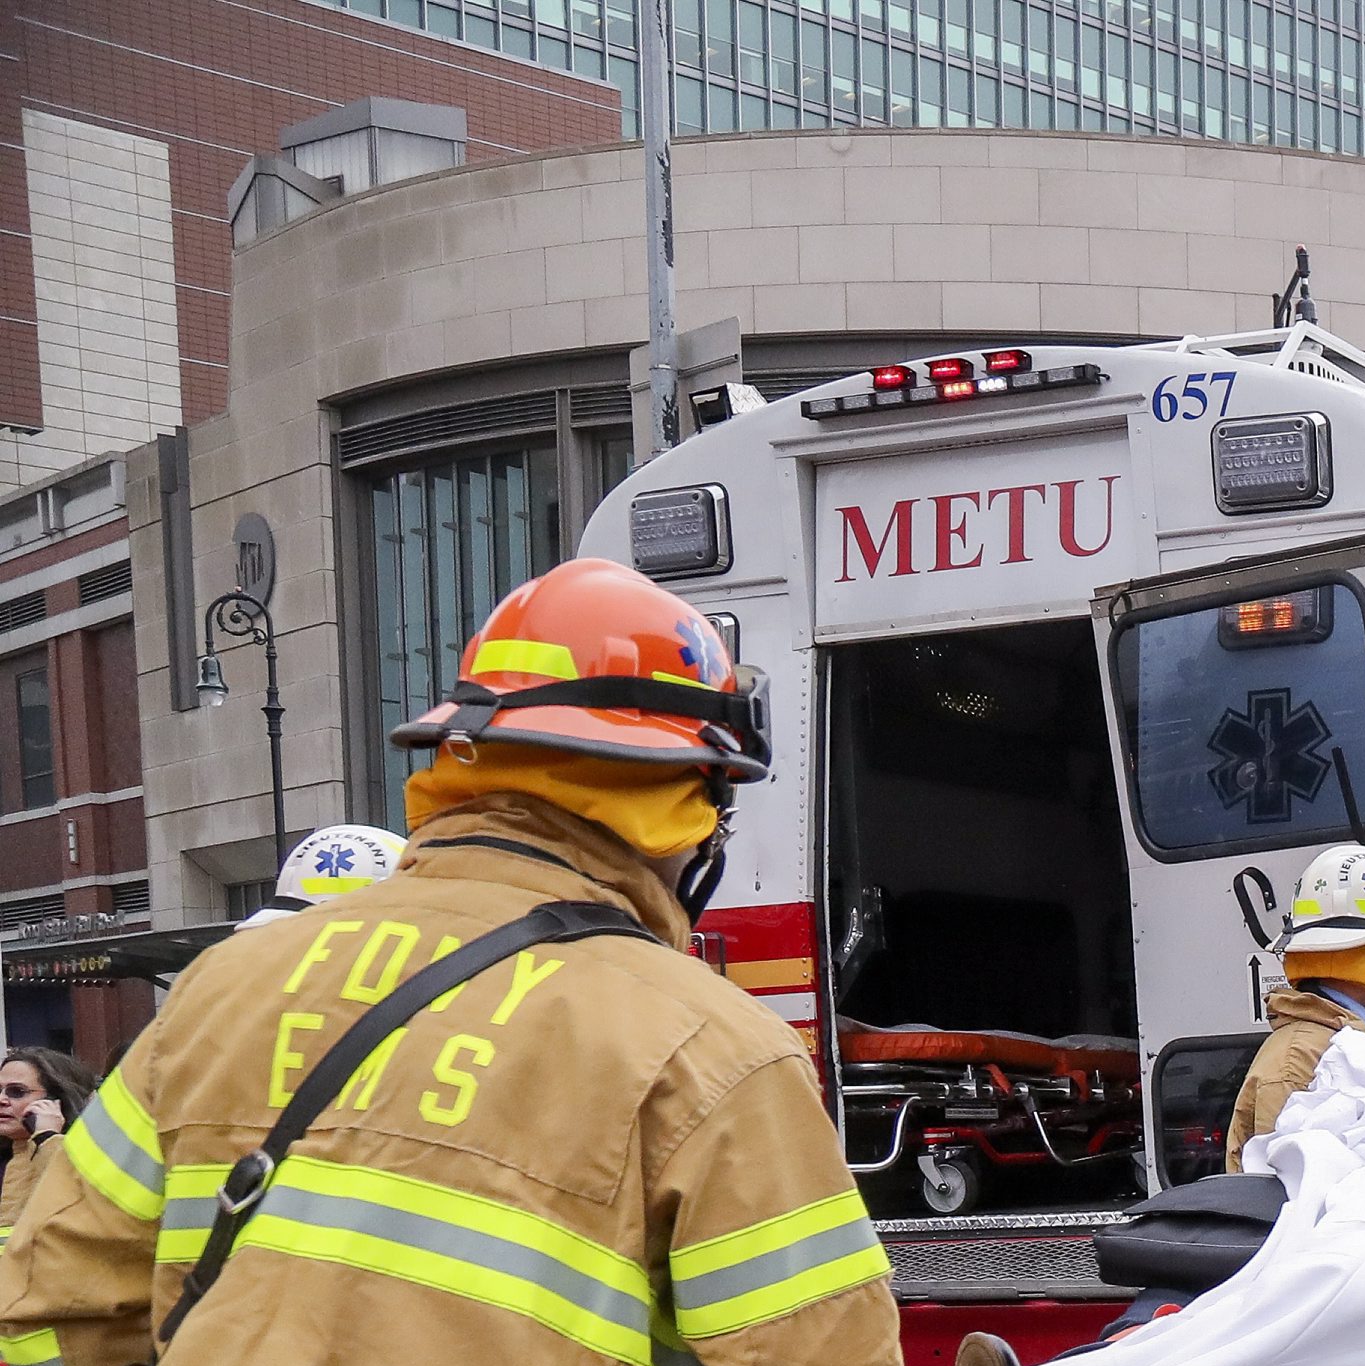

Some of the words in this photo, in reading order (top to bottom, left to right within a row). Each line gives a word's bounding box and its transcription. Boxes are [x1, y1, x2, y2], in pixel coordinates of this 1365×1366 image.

[1152, 371, 1238, 423] 657
[834, 475, 1122, 584] METU
[296, 833, 387, 869] LIEUTENANT
